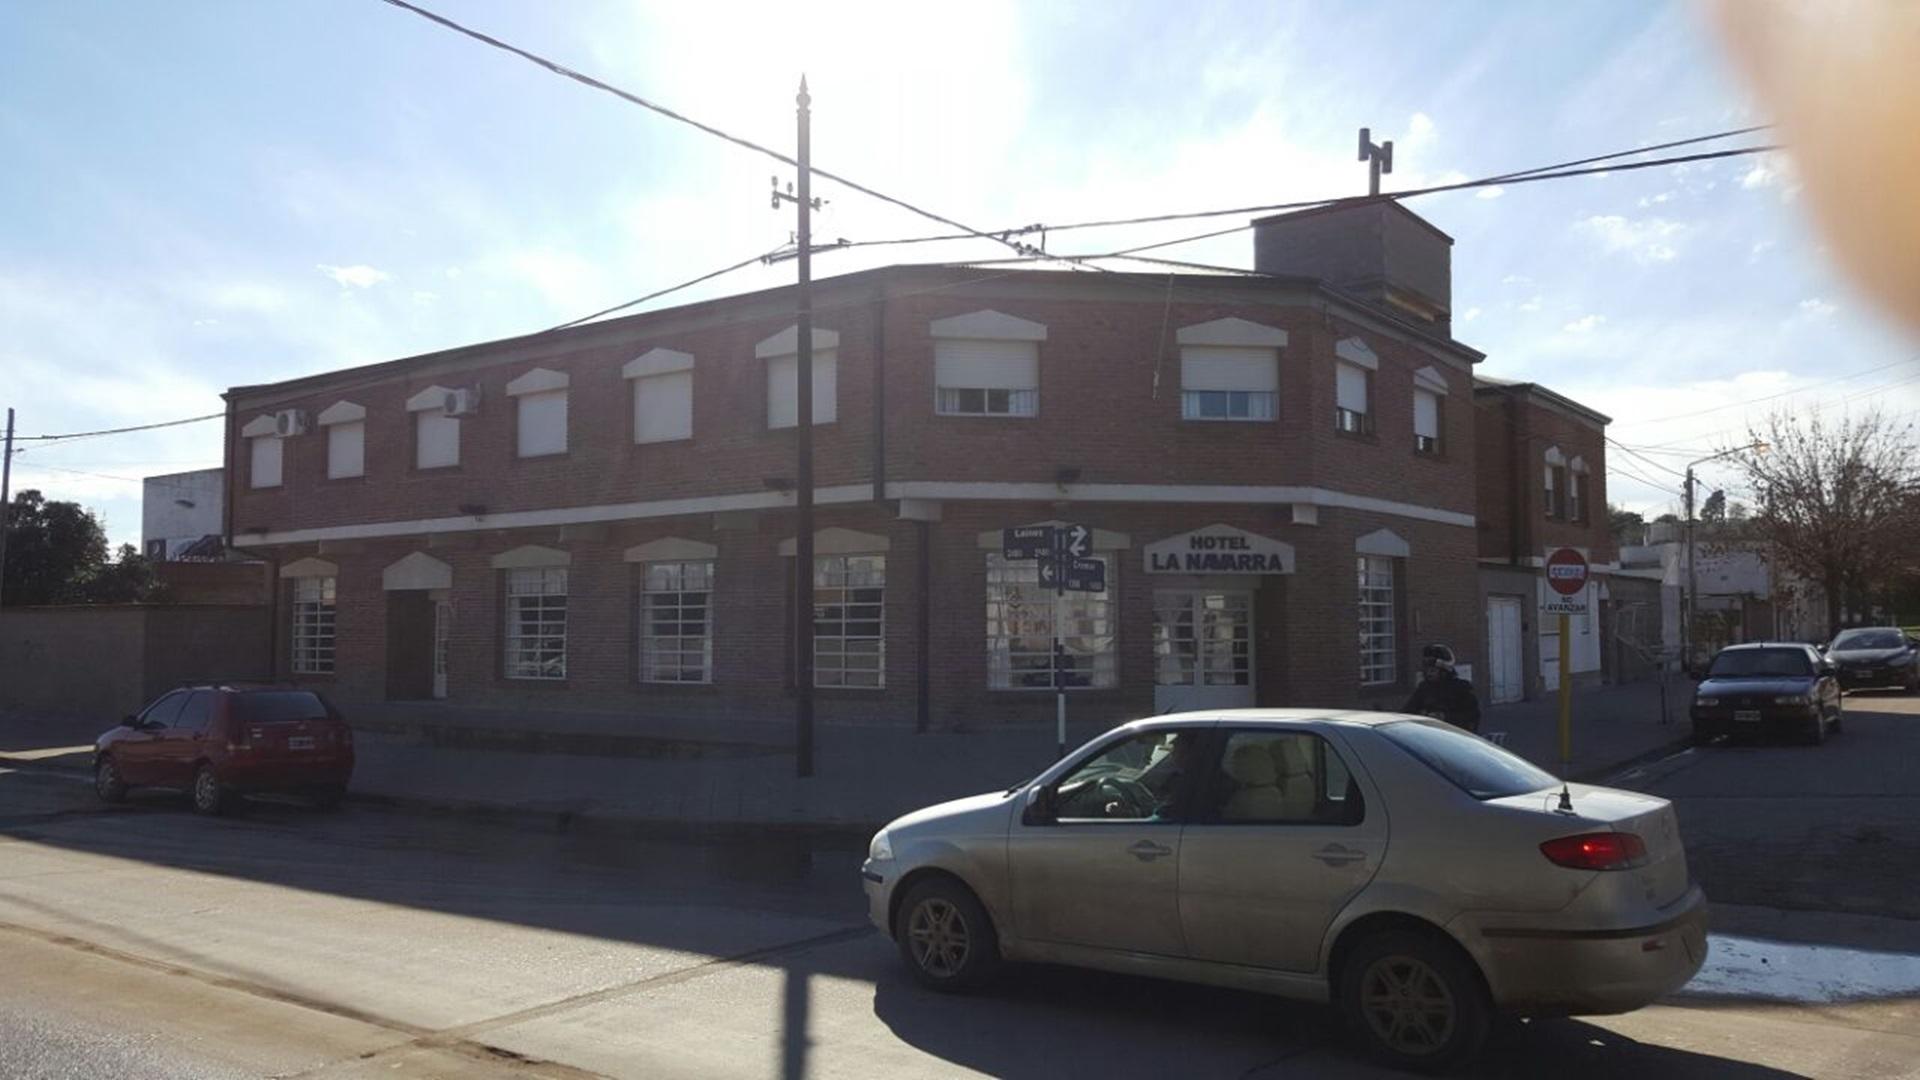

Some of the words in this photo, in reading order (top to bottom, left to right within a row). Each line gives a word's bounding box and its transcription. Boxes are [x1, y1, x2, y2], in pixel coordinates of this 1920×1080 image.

[1190, 536, 1250, 549] HOTEL
[1152, 553, 1180, 570] LA
[1186, 553, 1283, 571] NAVARRA
